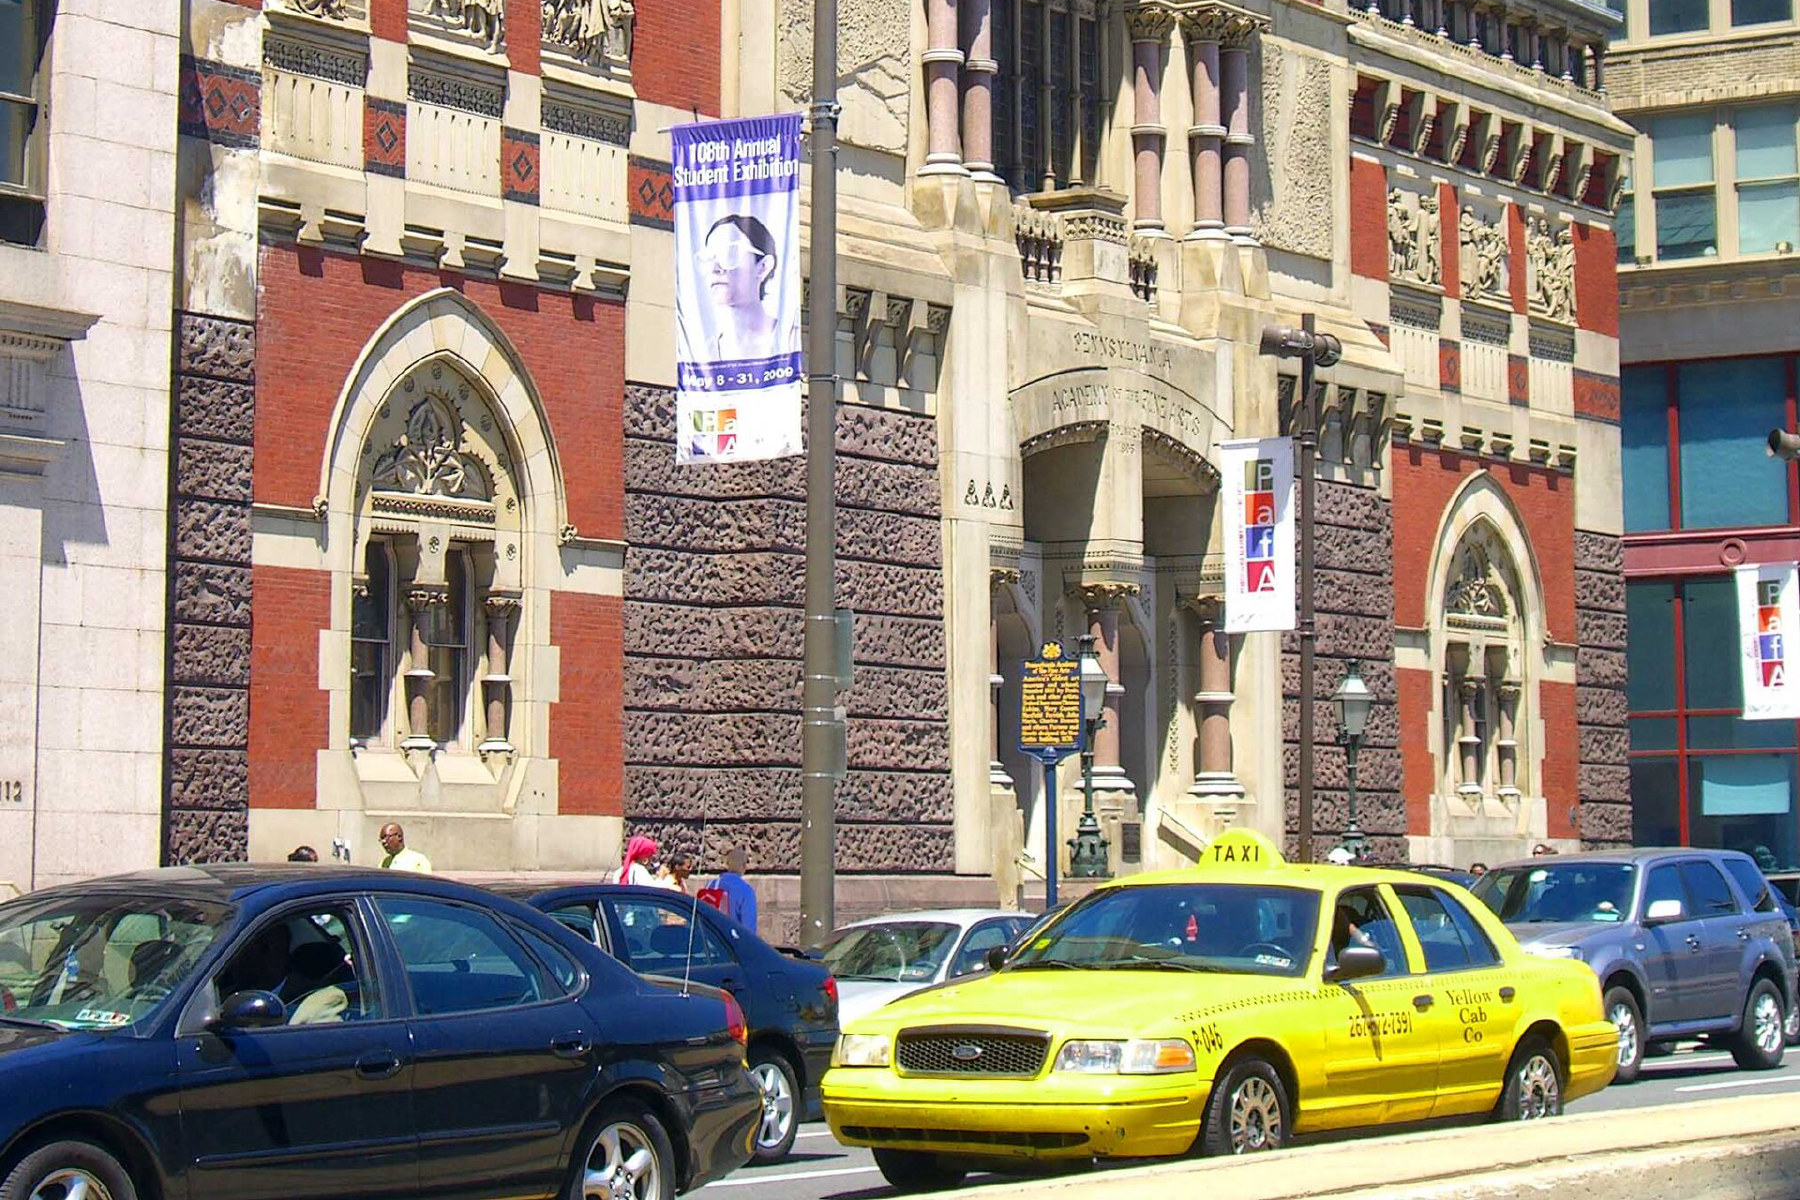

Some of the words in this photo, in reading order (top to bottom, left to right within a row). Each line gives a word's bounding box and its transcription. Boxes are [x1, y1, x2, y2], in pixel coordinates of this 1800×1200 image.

[689, 140, 730, 164] 108th
[734, 135, 781, 160] Annual
[674, 162, 729, 187] Student
[733, 156, 799, 182] Exhibition
[682, 373, 713, 390] May
[716, 374, 725, 386] 8
[763, 366, 794, 382] 2009
[1052, 384, 1109, 412] ACADEMY
[1213, 845, 1259, 862] TAXI
[1445, 988, 1492, 1006] Yellow
[1459, 1008, 1488, 1025] Cab
[1464, 1027, 1483, 1044] Co
